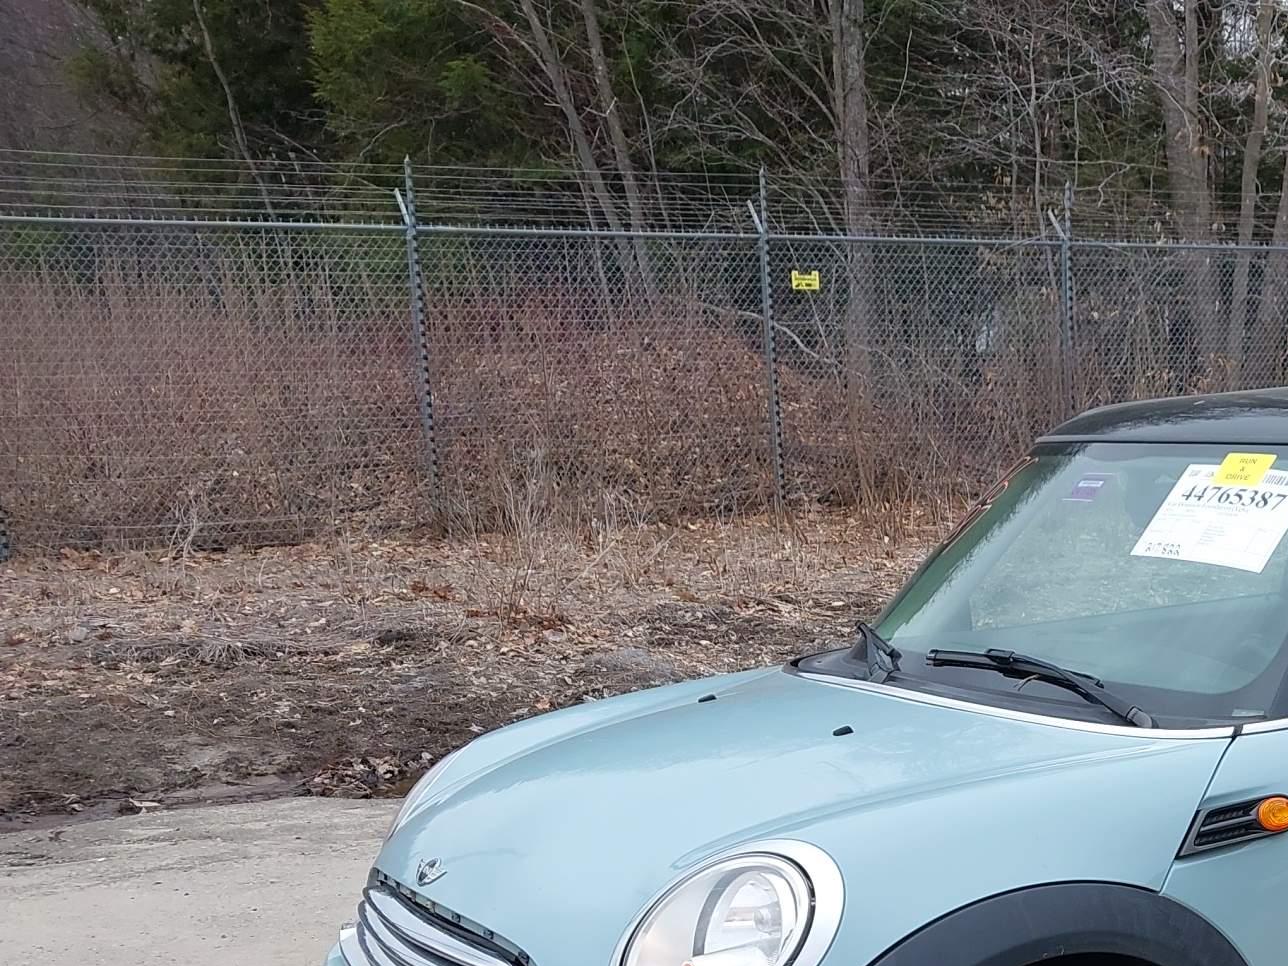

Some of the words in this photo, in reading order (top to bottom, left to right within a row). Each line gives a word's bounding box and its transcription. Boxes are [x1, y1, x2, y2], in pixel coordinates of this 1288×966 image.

[1239, 457, 1259, 466] RUN
[1225, 473, 1252, 481] DRIVE
[1181, 484, 1288, 511] 44765387
